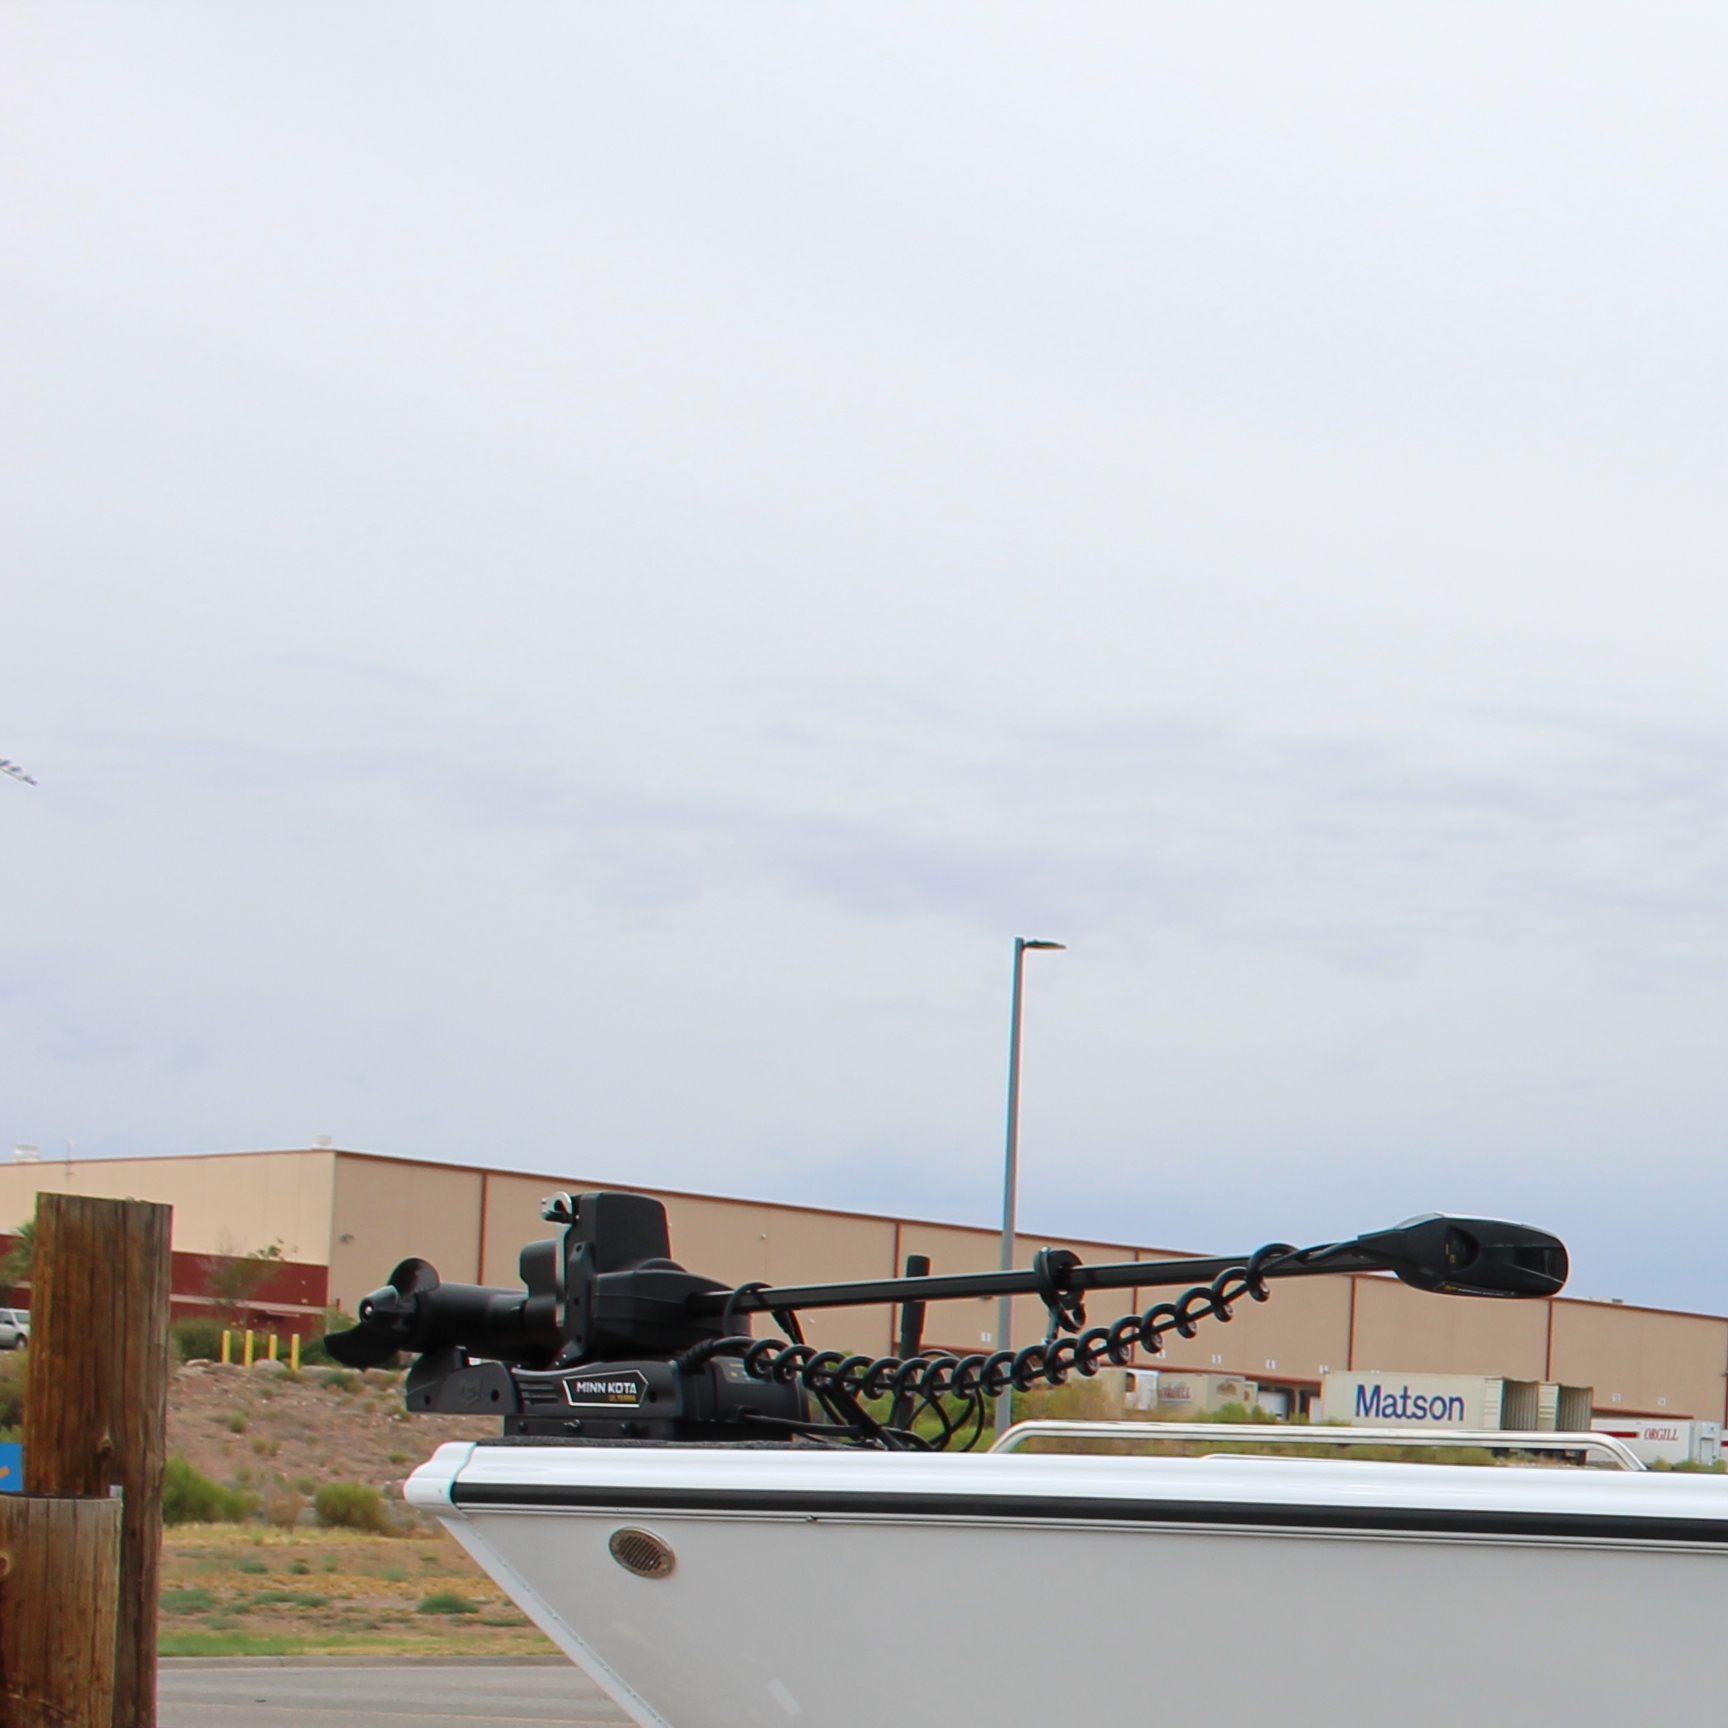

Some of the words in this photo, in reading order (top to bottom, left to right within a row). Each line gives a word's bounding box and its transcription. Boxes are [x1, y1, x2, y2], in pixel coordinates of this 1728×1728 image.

[576, 1381, 606, 1394] MINN
[608, 1382, 637, 1394] KOTA
[1355, 1384, 1465, 1421] Matson
[1644, 1428, 1679, 1441] ORGILL
